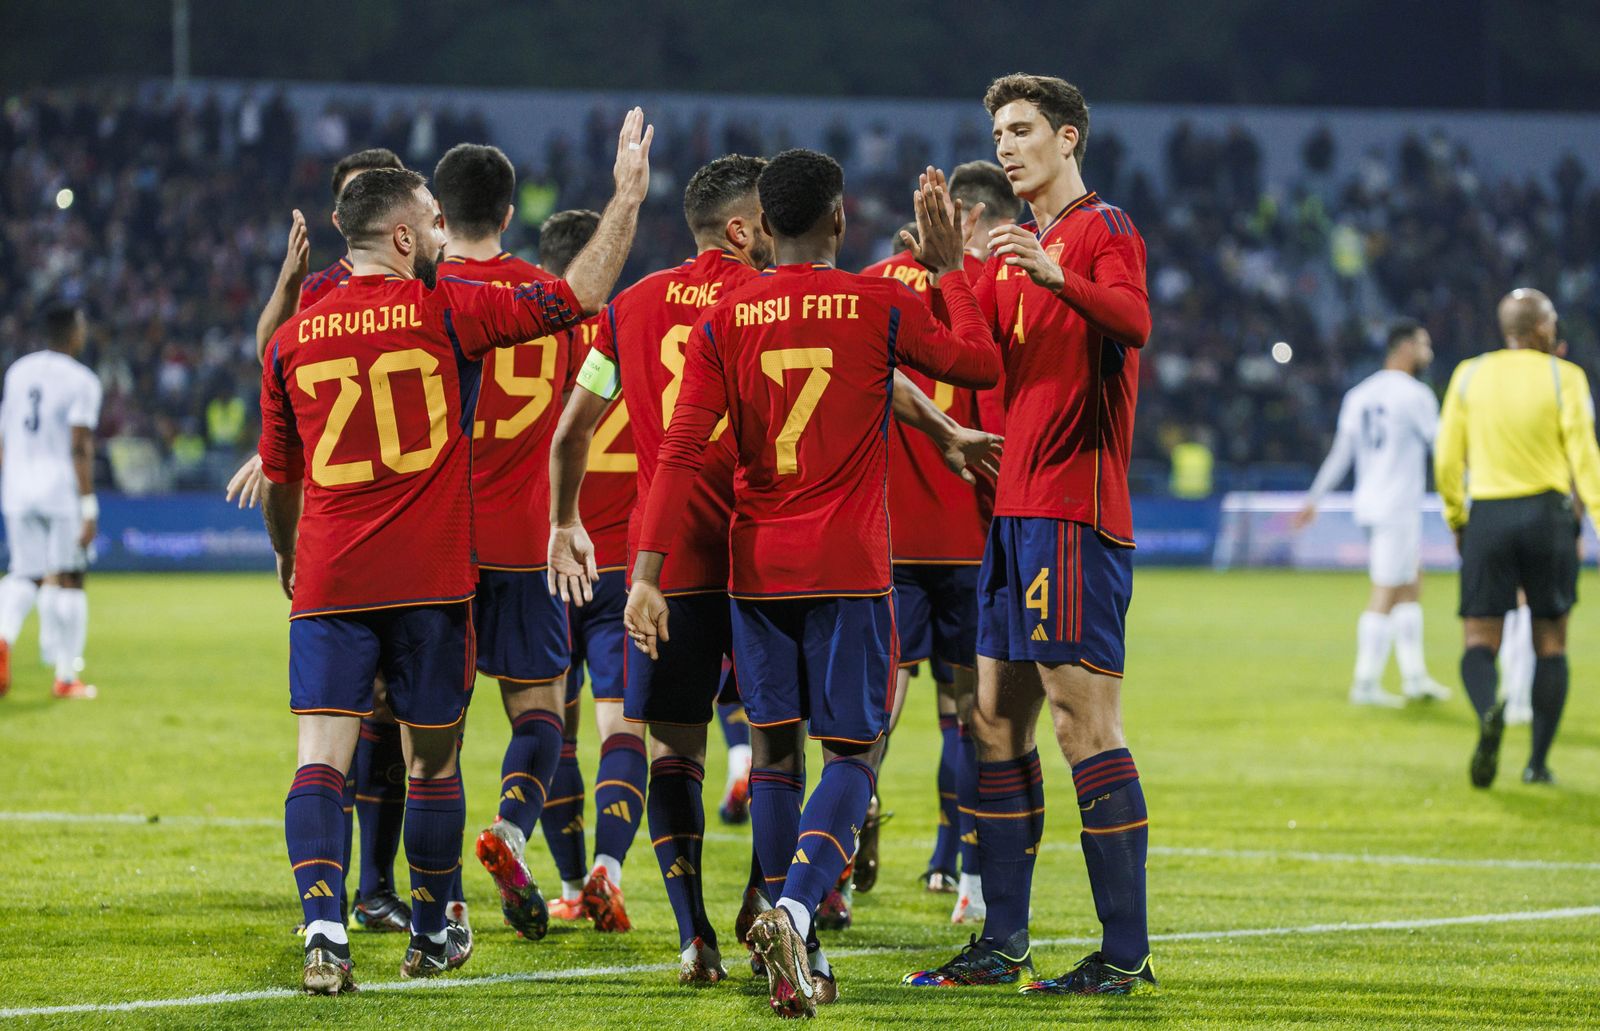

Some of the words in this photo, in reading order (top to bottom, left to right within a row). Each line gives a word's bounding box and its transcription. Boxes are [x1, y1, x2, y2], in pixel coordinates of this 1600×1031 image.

[666, 281, 720, 307] KOKE
[735, 297, 790, 327] ANSU
[802, 294, 859, 319] FATI
[298, 304, 422, 343] CARVAJAL
[24, 387, 42, 434] 3
[295, 348, 449, 487] 20
[761, 347, 834, 475] 7
[1025, 567, 1050, 620] 4
